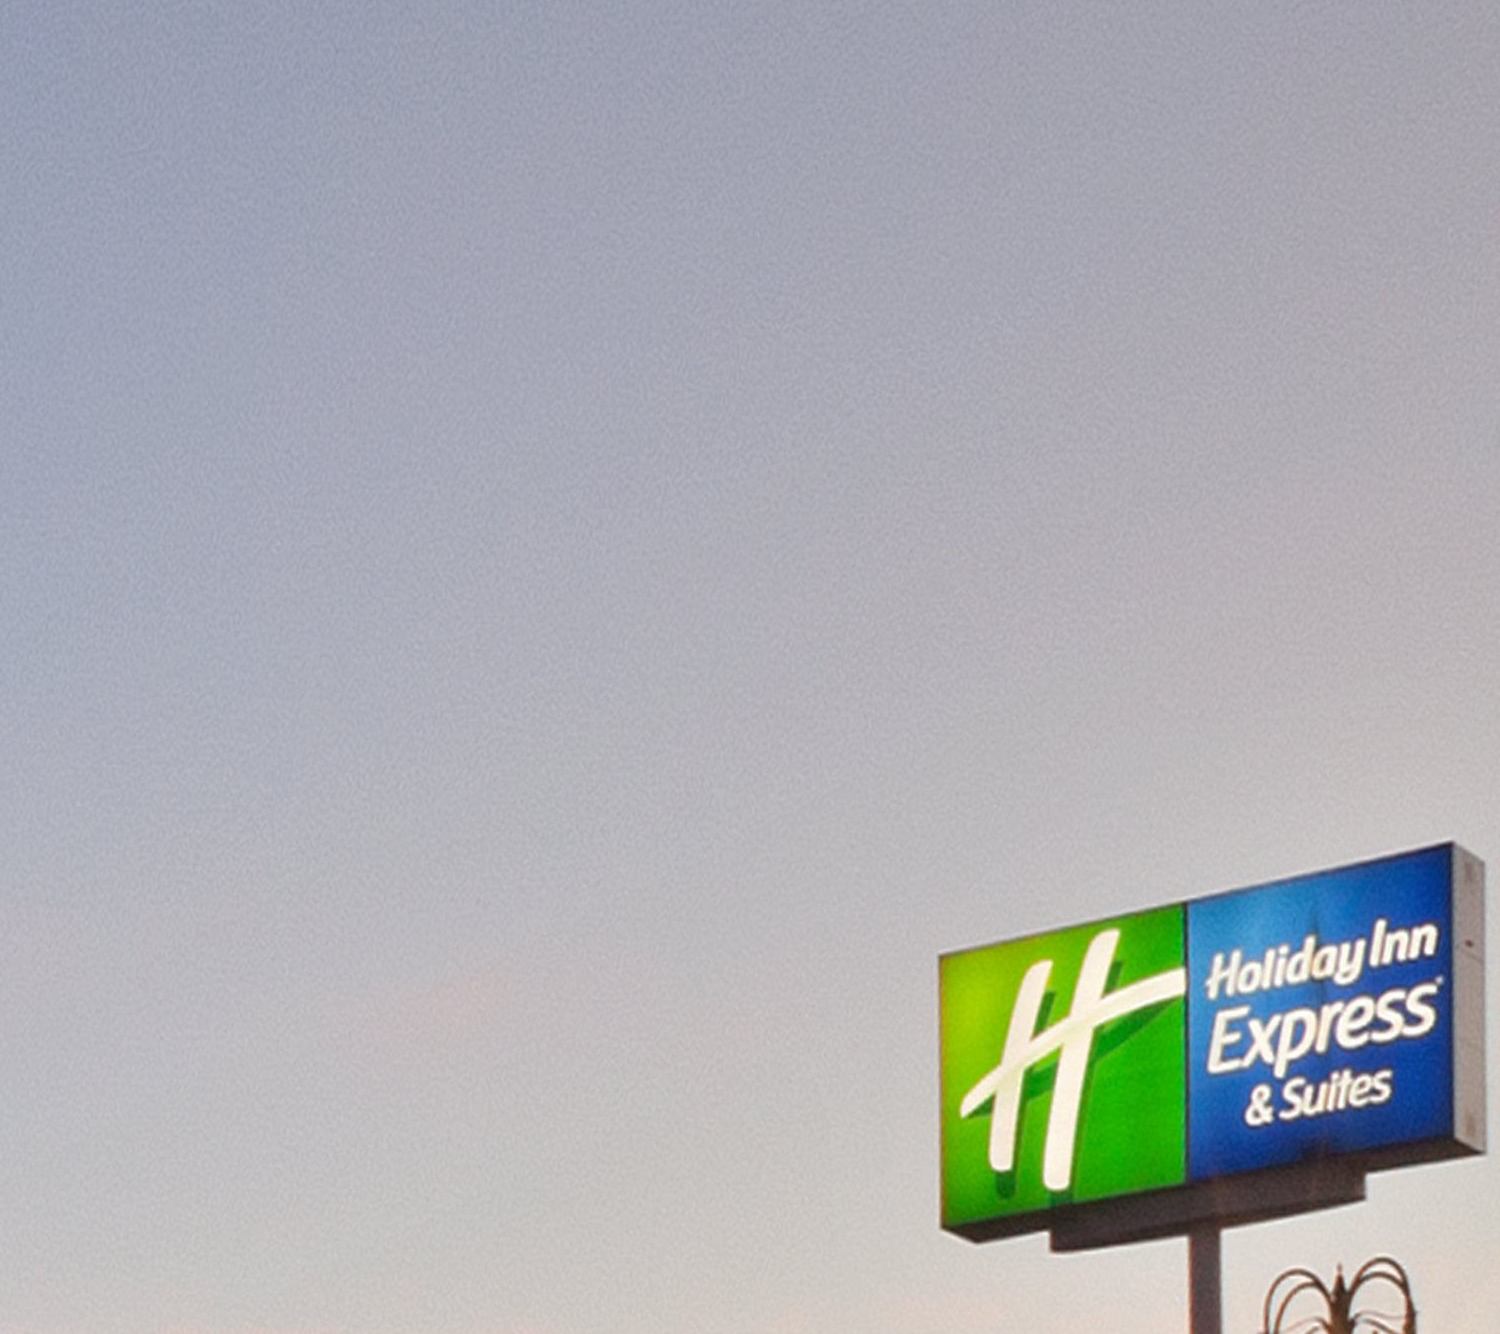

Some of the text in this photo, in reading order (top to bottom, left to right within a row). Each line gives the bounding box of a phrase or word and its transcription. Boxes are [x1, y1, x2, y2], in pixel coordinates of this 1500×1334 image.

[1205, 919, 1438, 1000] Holiday Inn
[1206, 983, 1438, 1078] Express
[1244, 1069, 1393, 1127] & Suites
